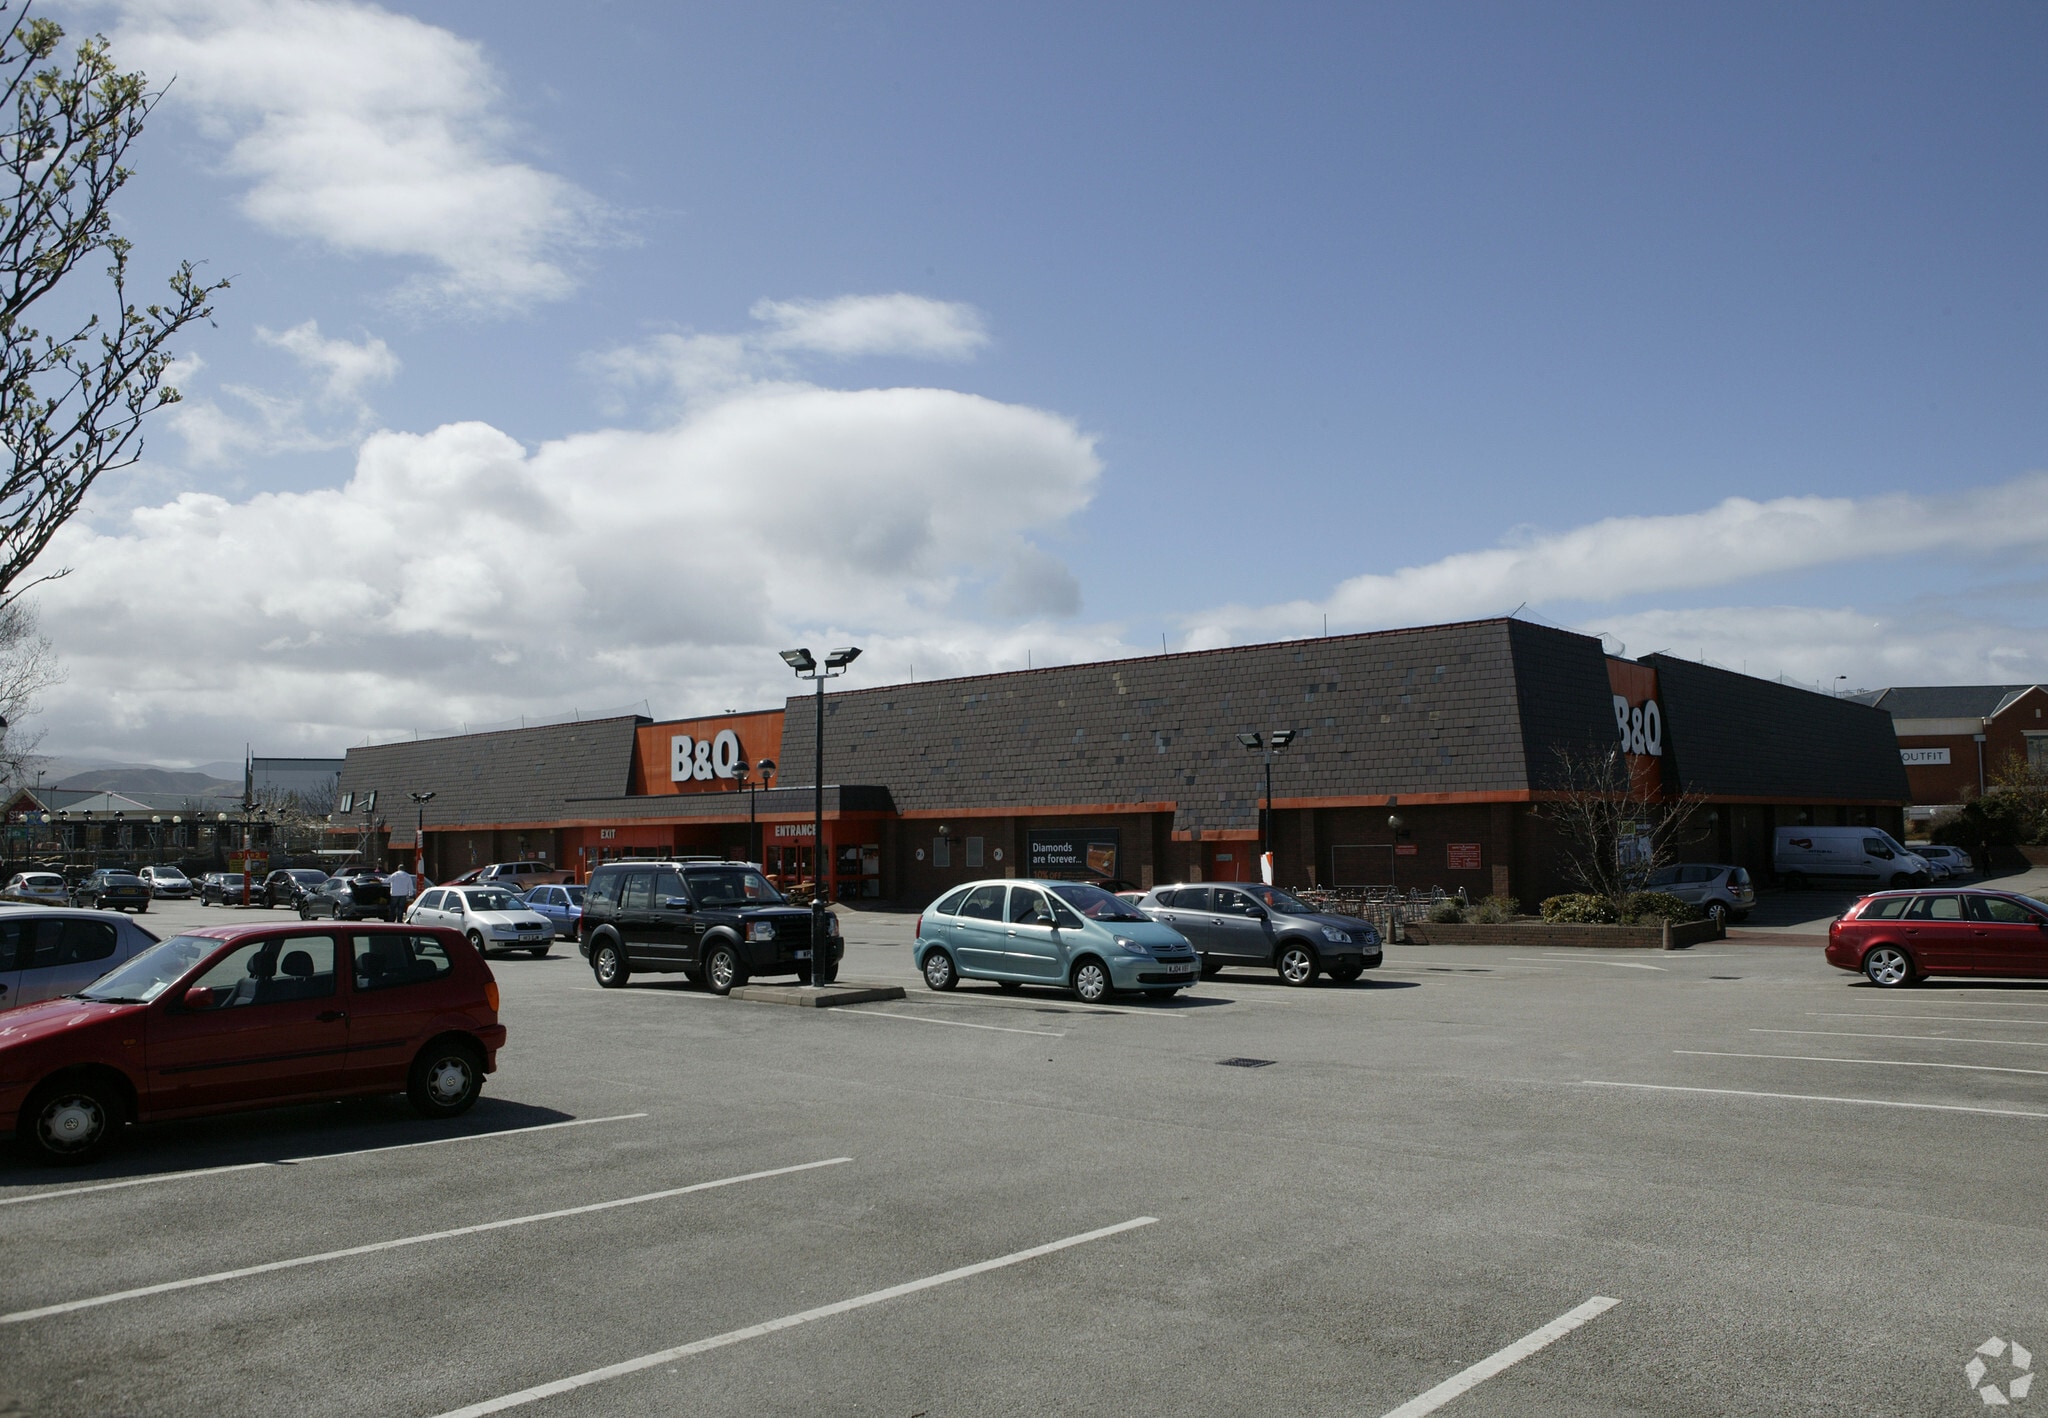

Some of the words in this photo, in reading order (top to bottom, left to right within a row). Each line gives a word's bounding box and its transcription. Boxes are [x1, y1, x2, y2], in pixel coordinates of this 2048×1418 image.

[1613, 694, 1662, 756] B&Q
[671, 729, 738, 782] B&Q
[1902, 751, 1943, 761] OUTFIT
[601, 828, 616, 840] EXIT
[1032, 842, 1073, 853] Diamonds
[1032, 856, 1046, 864] are
[1047, 853, 1082, 864] forever...
